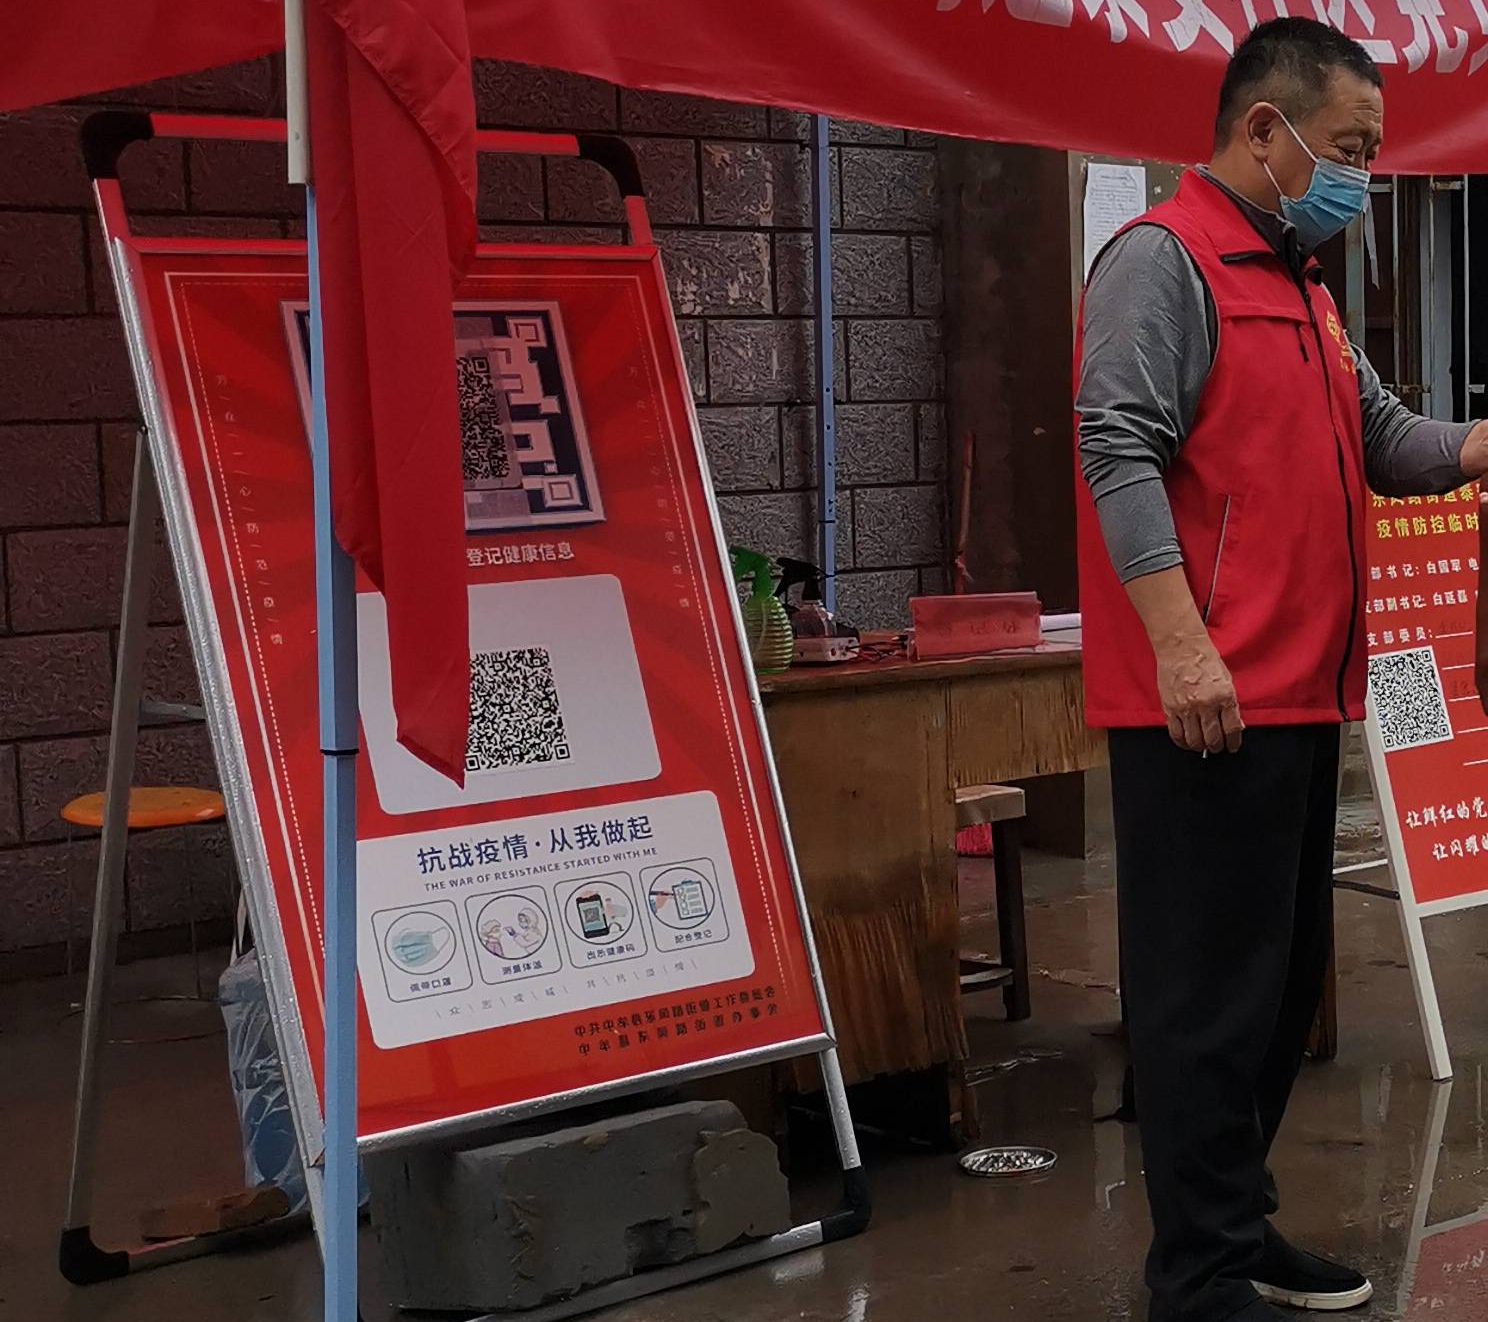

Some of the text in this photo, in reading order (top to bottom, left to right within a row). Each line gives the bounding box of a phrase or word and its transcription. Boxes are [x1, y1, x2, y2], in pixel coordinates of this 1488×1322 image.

[466, 541, 575, 567] 登记健康信息
[424, 847, 658, 892] THE WAR OF RESISTANCE STARTED WITH ME
